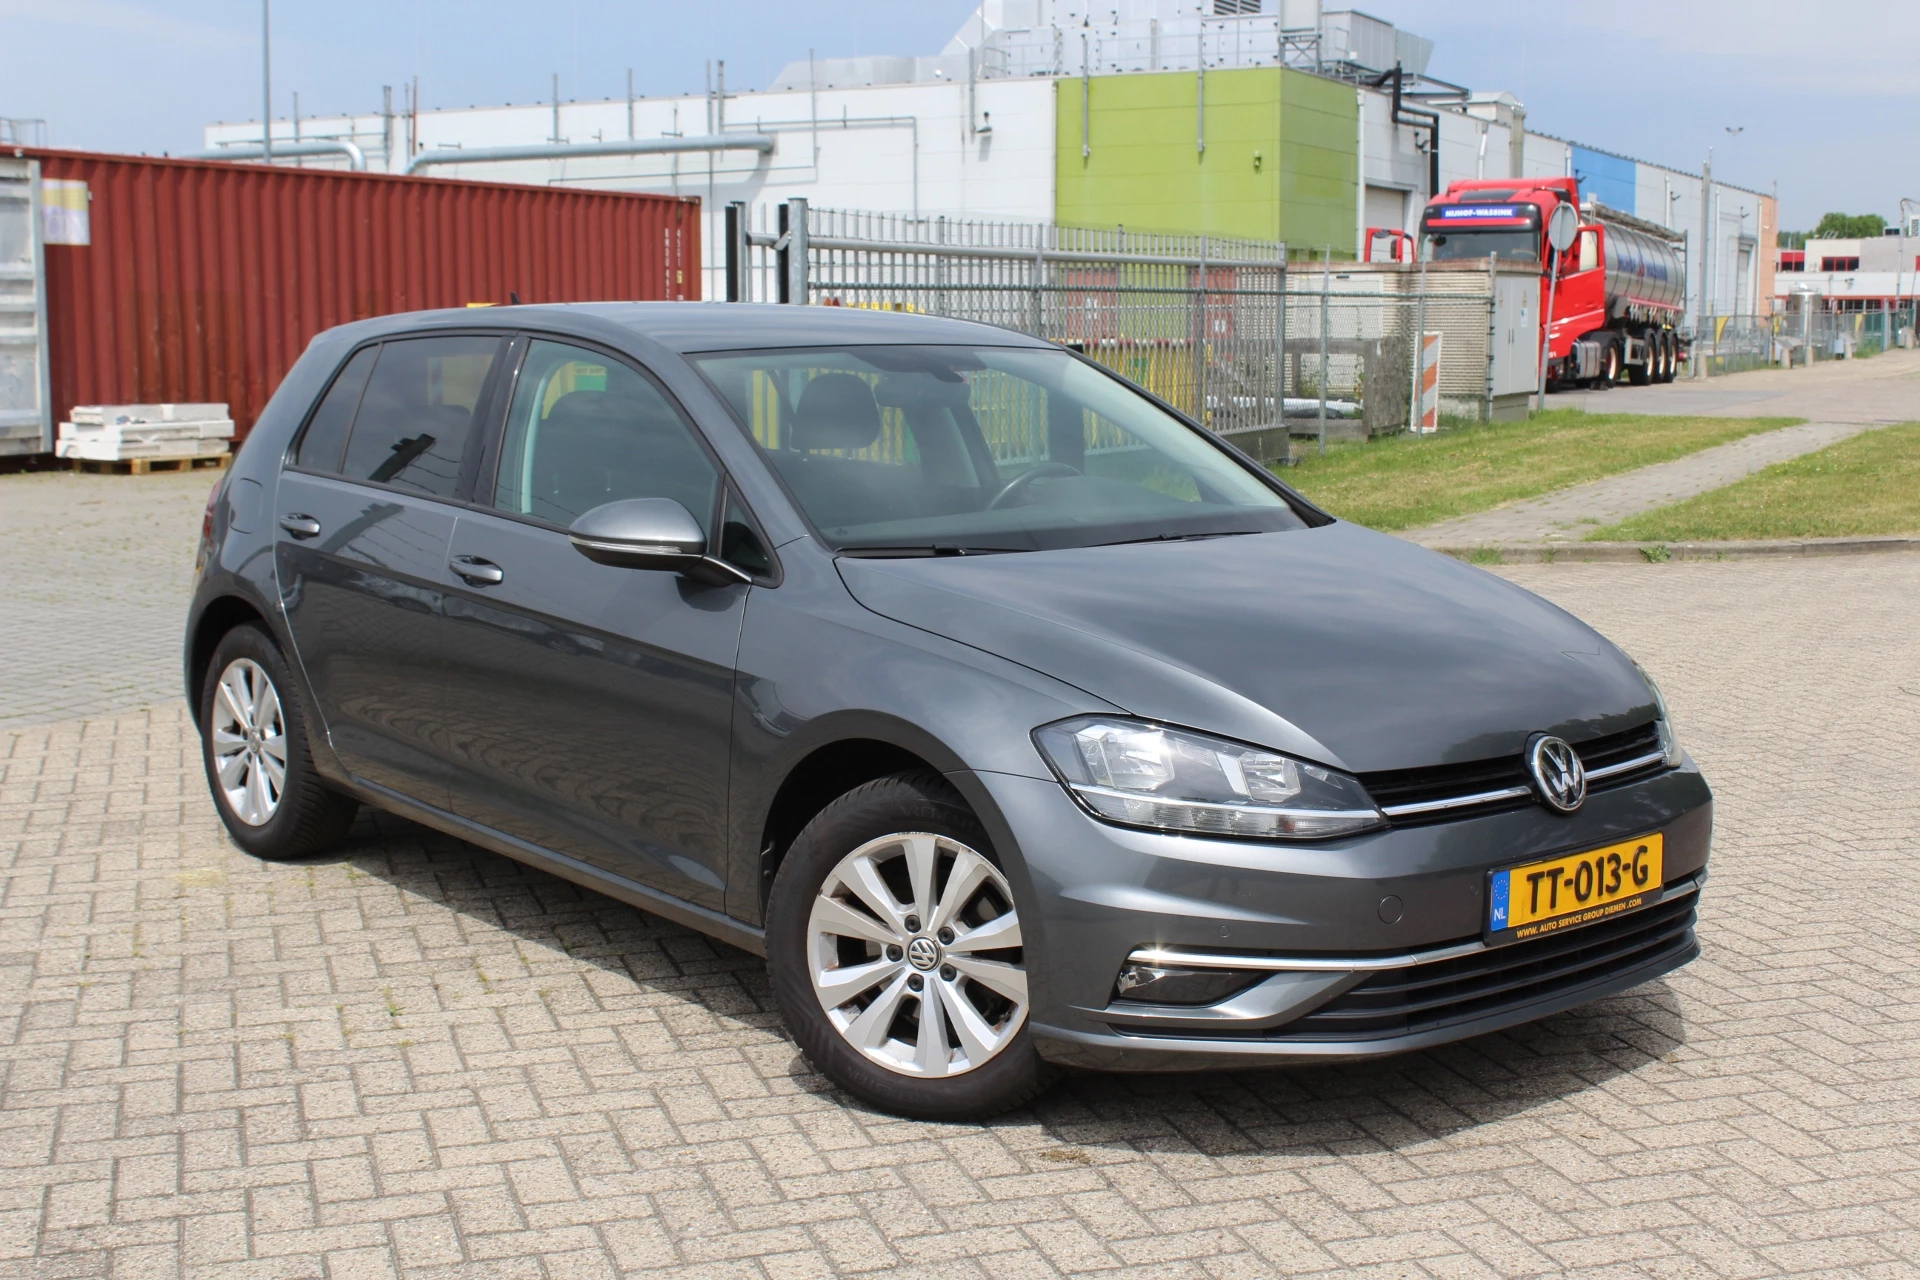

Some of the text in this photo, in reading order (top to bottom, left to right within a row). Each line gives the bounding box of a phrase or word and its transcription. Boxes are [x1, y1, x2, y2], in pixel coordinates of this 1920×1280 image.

[1445, 208, 1513, 218] NIJHOF-WASSINK
[1526, 845, 1648, 914] TT-013-G
[1493, 906, 1507, 922] NL
[1516, 897, 1642, 939] WWW. AUTO SERVICE GROUP DIEMEN .COM
